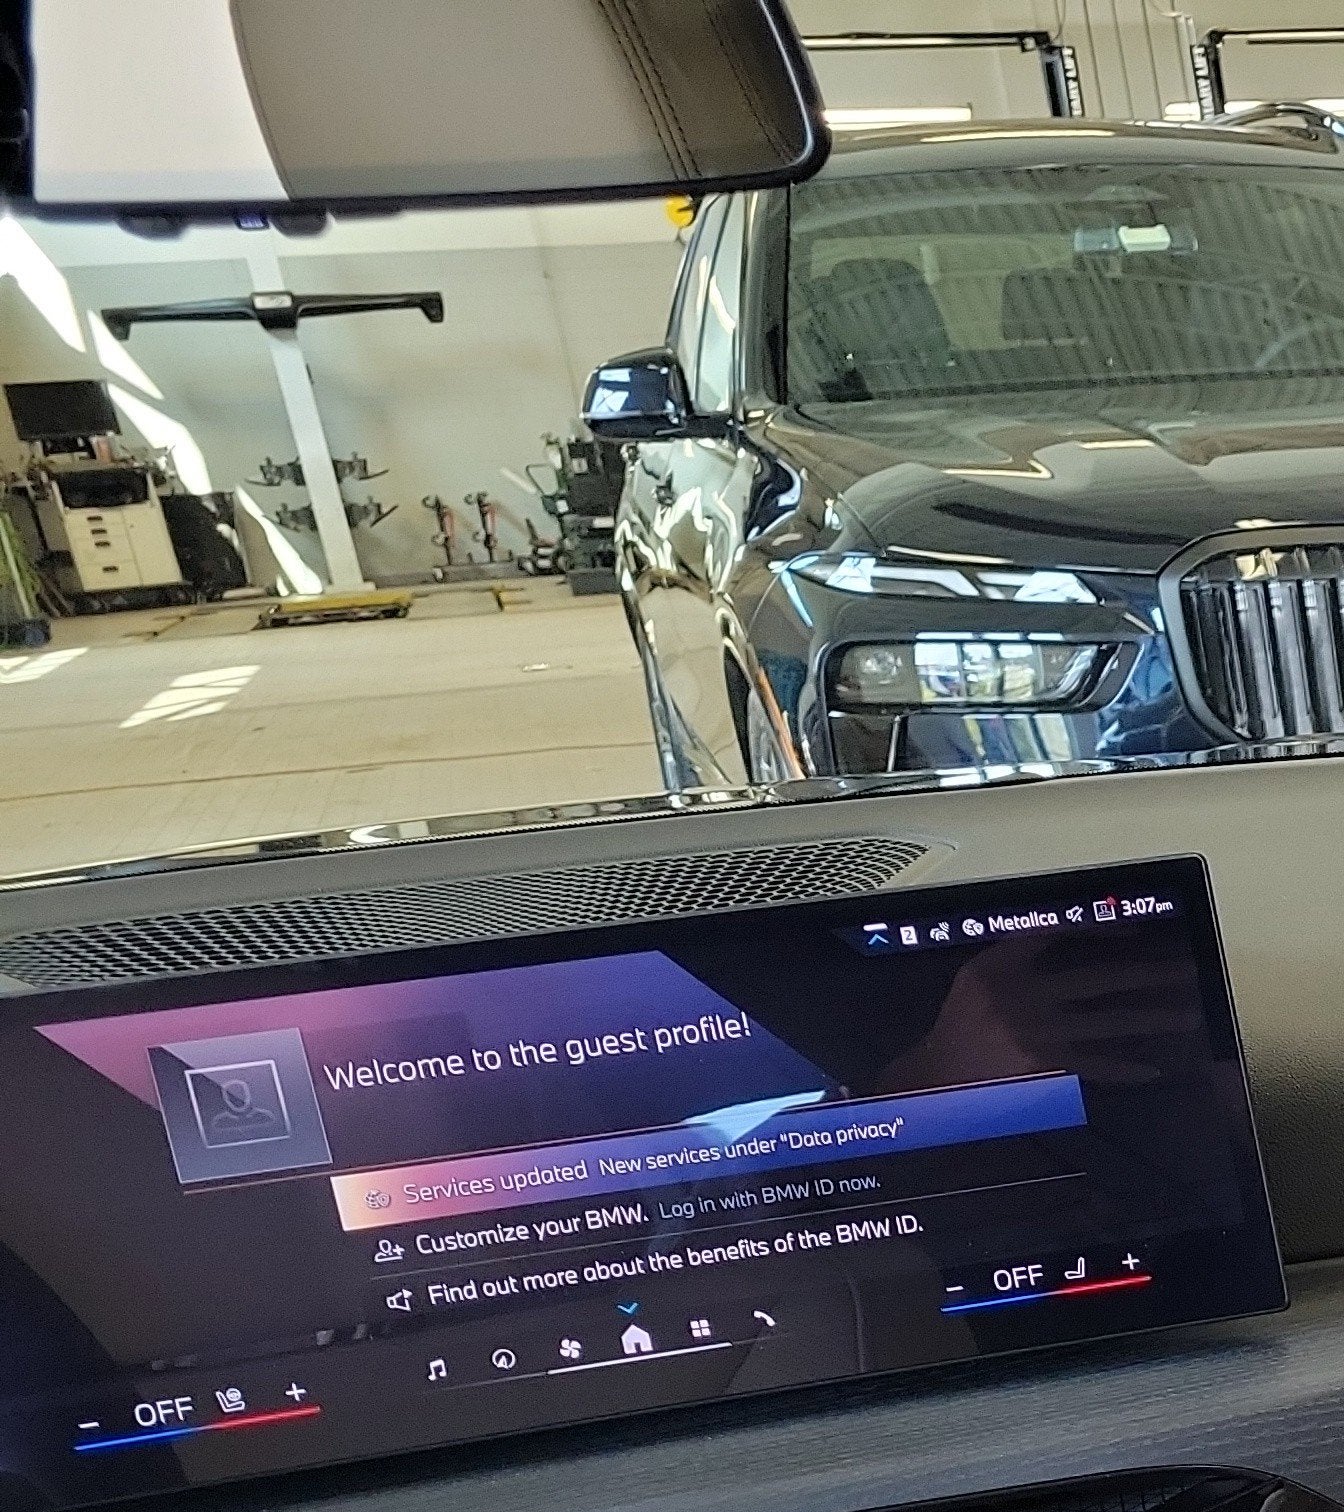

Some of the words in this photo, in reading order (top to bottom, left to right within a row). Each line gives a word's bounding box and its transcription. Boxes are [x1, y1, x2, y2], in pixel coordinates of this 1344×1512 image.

[323, 1052, 465, 1090] Welcome
[472, 1047, 502, 1073] to
[510, 1040, 557, 1068] the
[567, 1027, 649, 1066] guest
[655, 1011, 752, 1053] profile!
[403, 1175, 496, 1203] Services
[500, 1159, 589, 1192] updated
[598, 1156, 642, 1176] New
[647, 1146, 721, 1170] services
[724, 1138, 777, 1158] under
[780, 1132, 832, 1150] "Data
[836, 1117, 905, 1146] privacy"
[416, 1223, 530, 1255] Customize
[532, 1216, 582, 1241] your
[584, 1203, 649, 1231] BMW.
[658, 1200, 695, 1220] Log
[699, 1196, 716, 1214] in
[719, 1189, 758, 1210] with
[761, 1181, 810, 1205] BMW
[814, 1178, 834, 1197] ID
[838, 1174, 882, 1194] now.
[428, 1280, 479, 1306] Find
[483, 1276, 519, 1297] out
[523, 1268, 579, 1291] more
[584, 1257, 646, 1282] about
[649, 1250, 683, 1272] the
[687, 1238, 770, 1266] benefits
[774, 1232, 796, 1252] of
[798, 1229, 832, 1248] the
[835, 1217, 891, 1244] BMW
[895, 1214, 924, 1235] ID.
[993, 1264, 1045, 1292] OFF
[133, 1397, 196, 1428] OFF
